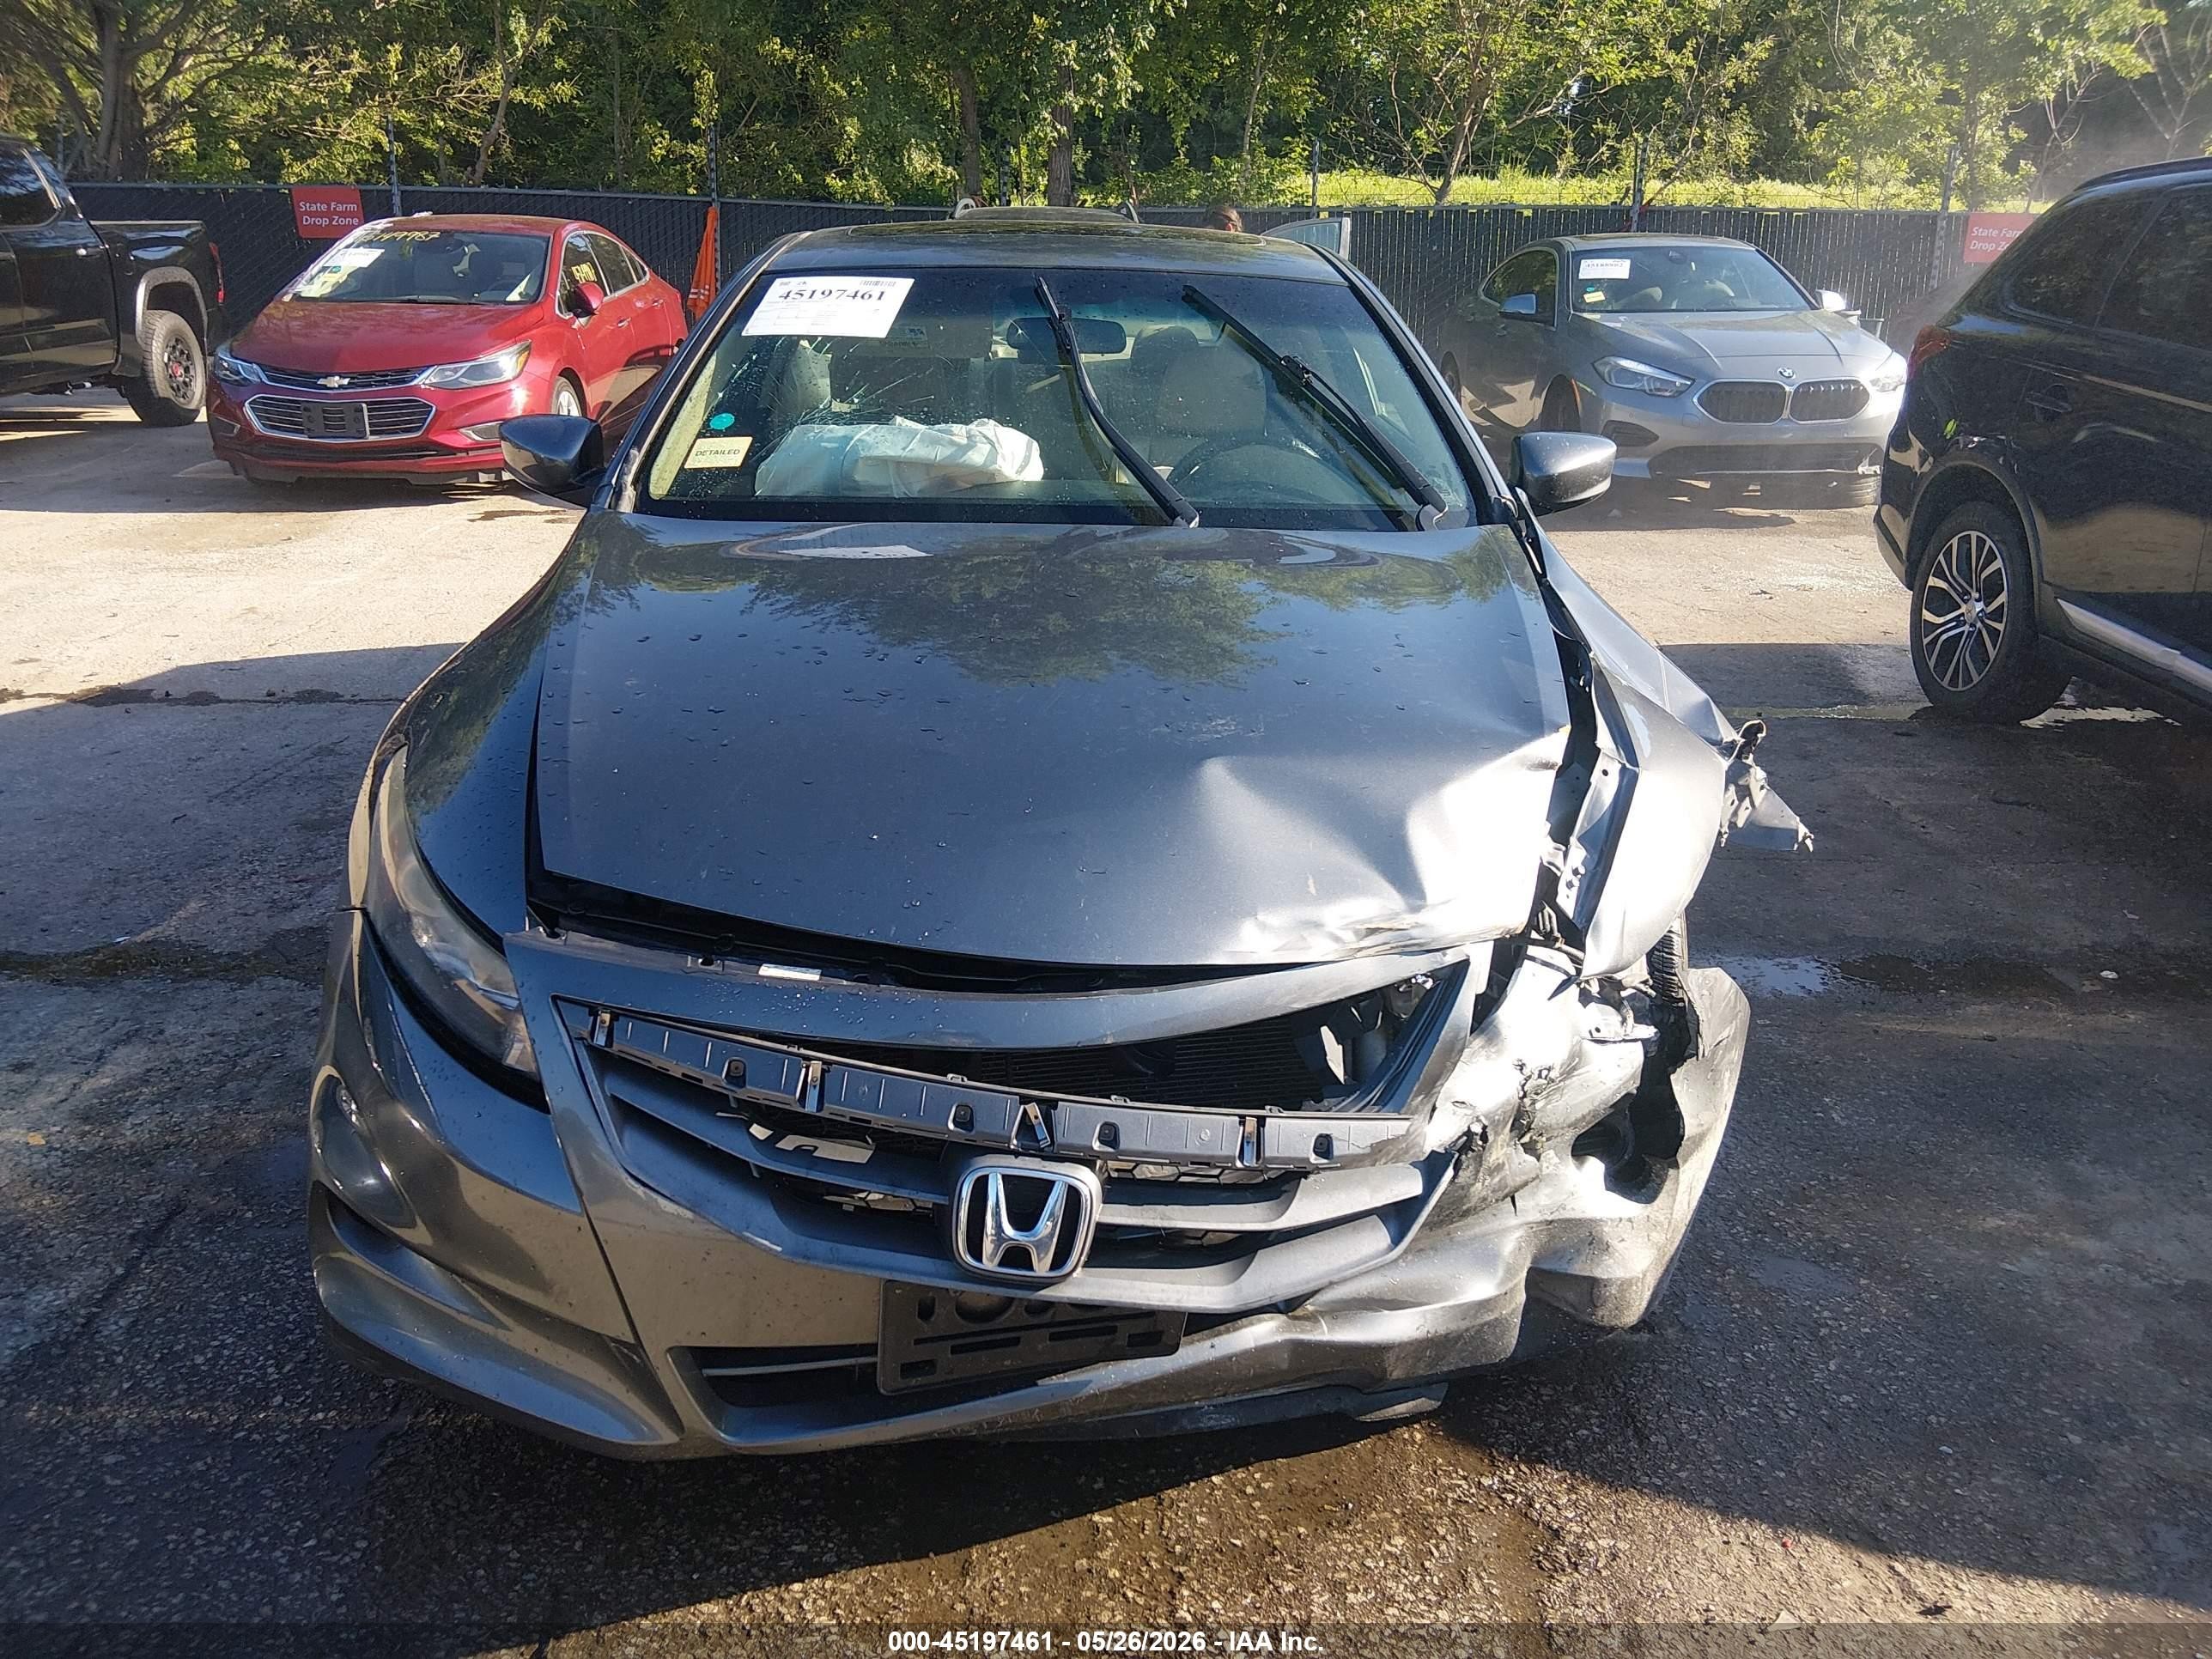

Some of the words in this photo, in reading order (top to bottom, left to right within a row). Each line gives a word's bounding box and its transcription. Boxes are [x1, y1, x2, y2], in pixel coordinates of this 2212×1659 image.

[299, 201, 329, 212] State
[330, 202, 358, 212] Farm
[302, 216, 330, 228] Drop
[331, 216, 359, 226] Zone
[1971, 226, 1999, 237] State
[1969, 240, 1996, 252] Drop
[779, 289, 885, 301] 45197461
[695, 448, 740, 457] DETAILED
